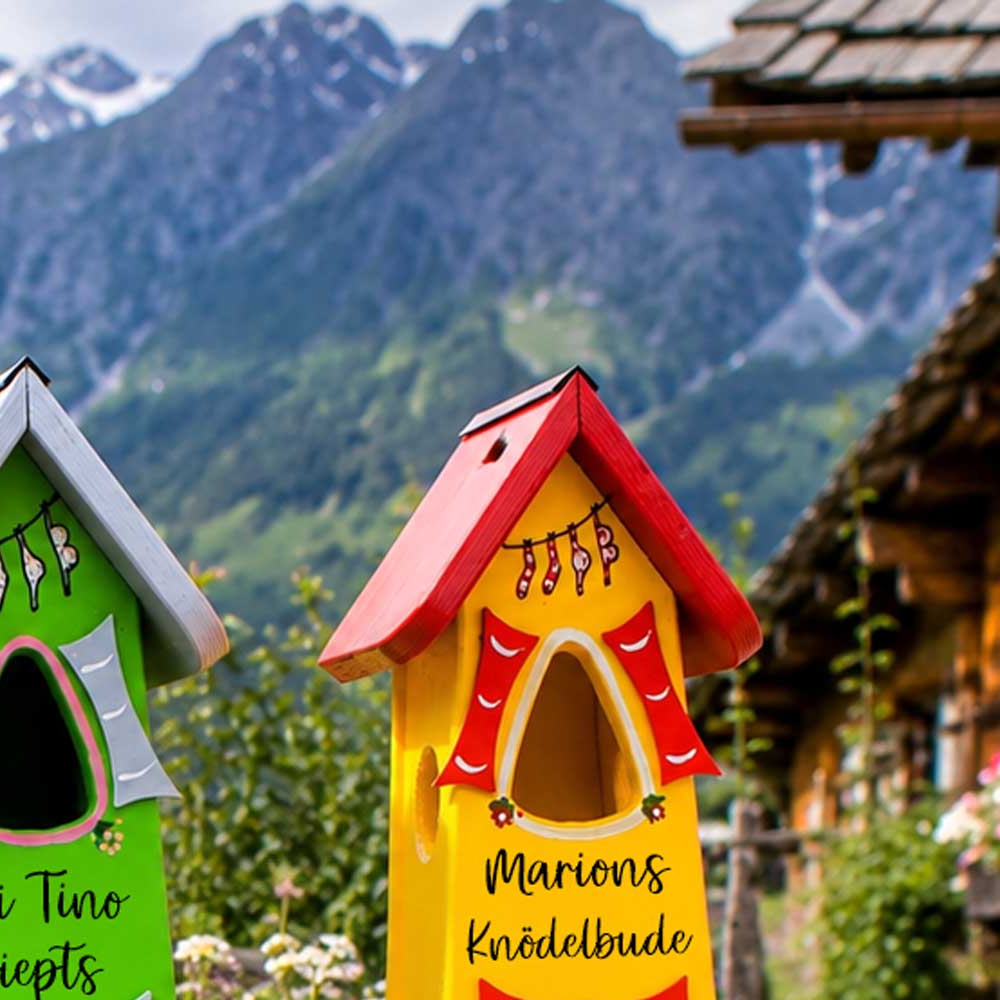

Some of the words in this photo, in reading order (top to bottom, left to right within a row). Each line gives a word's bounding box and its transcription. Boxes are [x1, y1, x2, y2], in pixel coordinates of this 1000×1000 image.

[24, 869, 131, 924] Tino
[485, 848, 671, 896] Marions
[466, 913, 692, 965] Knödelbude
